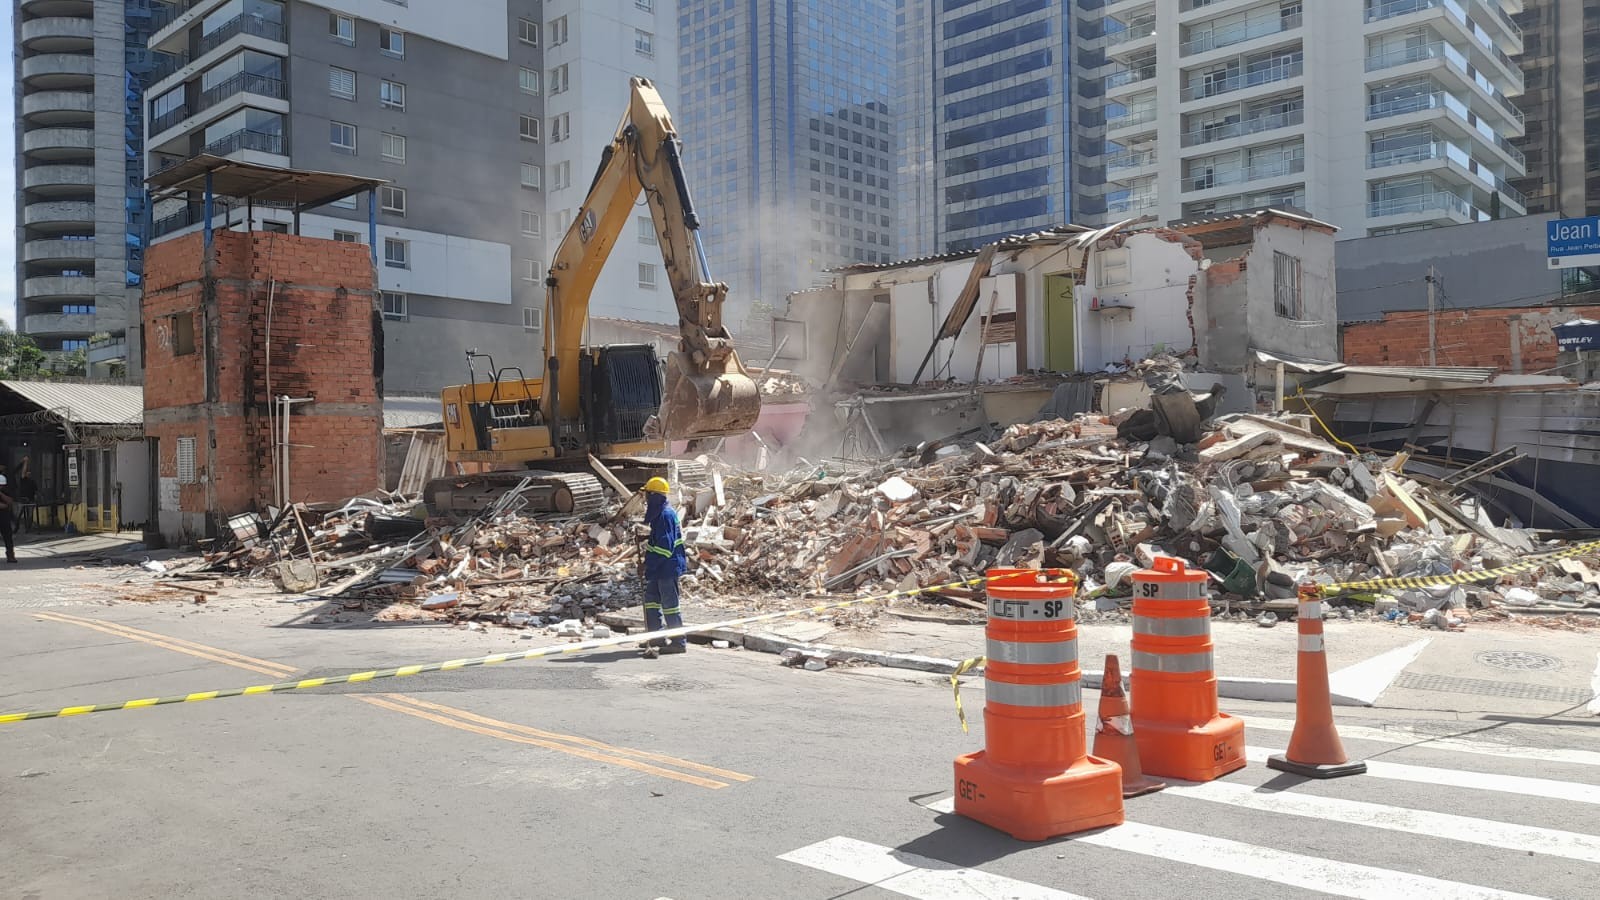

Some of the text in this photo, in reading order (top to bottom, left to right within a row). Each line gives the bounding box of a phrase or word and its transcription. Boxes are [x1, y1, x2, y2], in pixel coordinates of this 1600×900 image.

[1550, 223, 1590, 241] Jean
[1142, 583, 1159, 597] SP
[1044, 600, 1063, 618] SP
